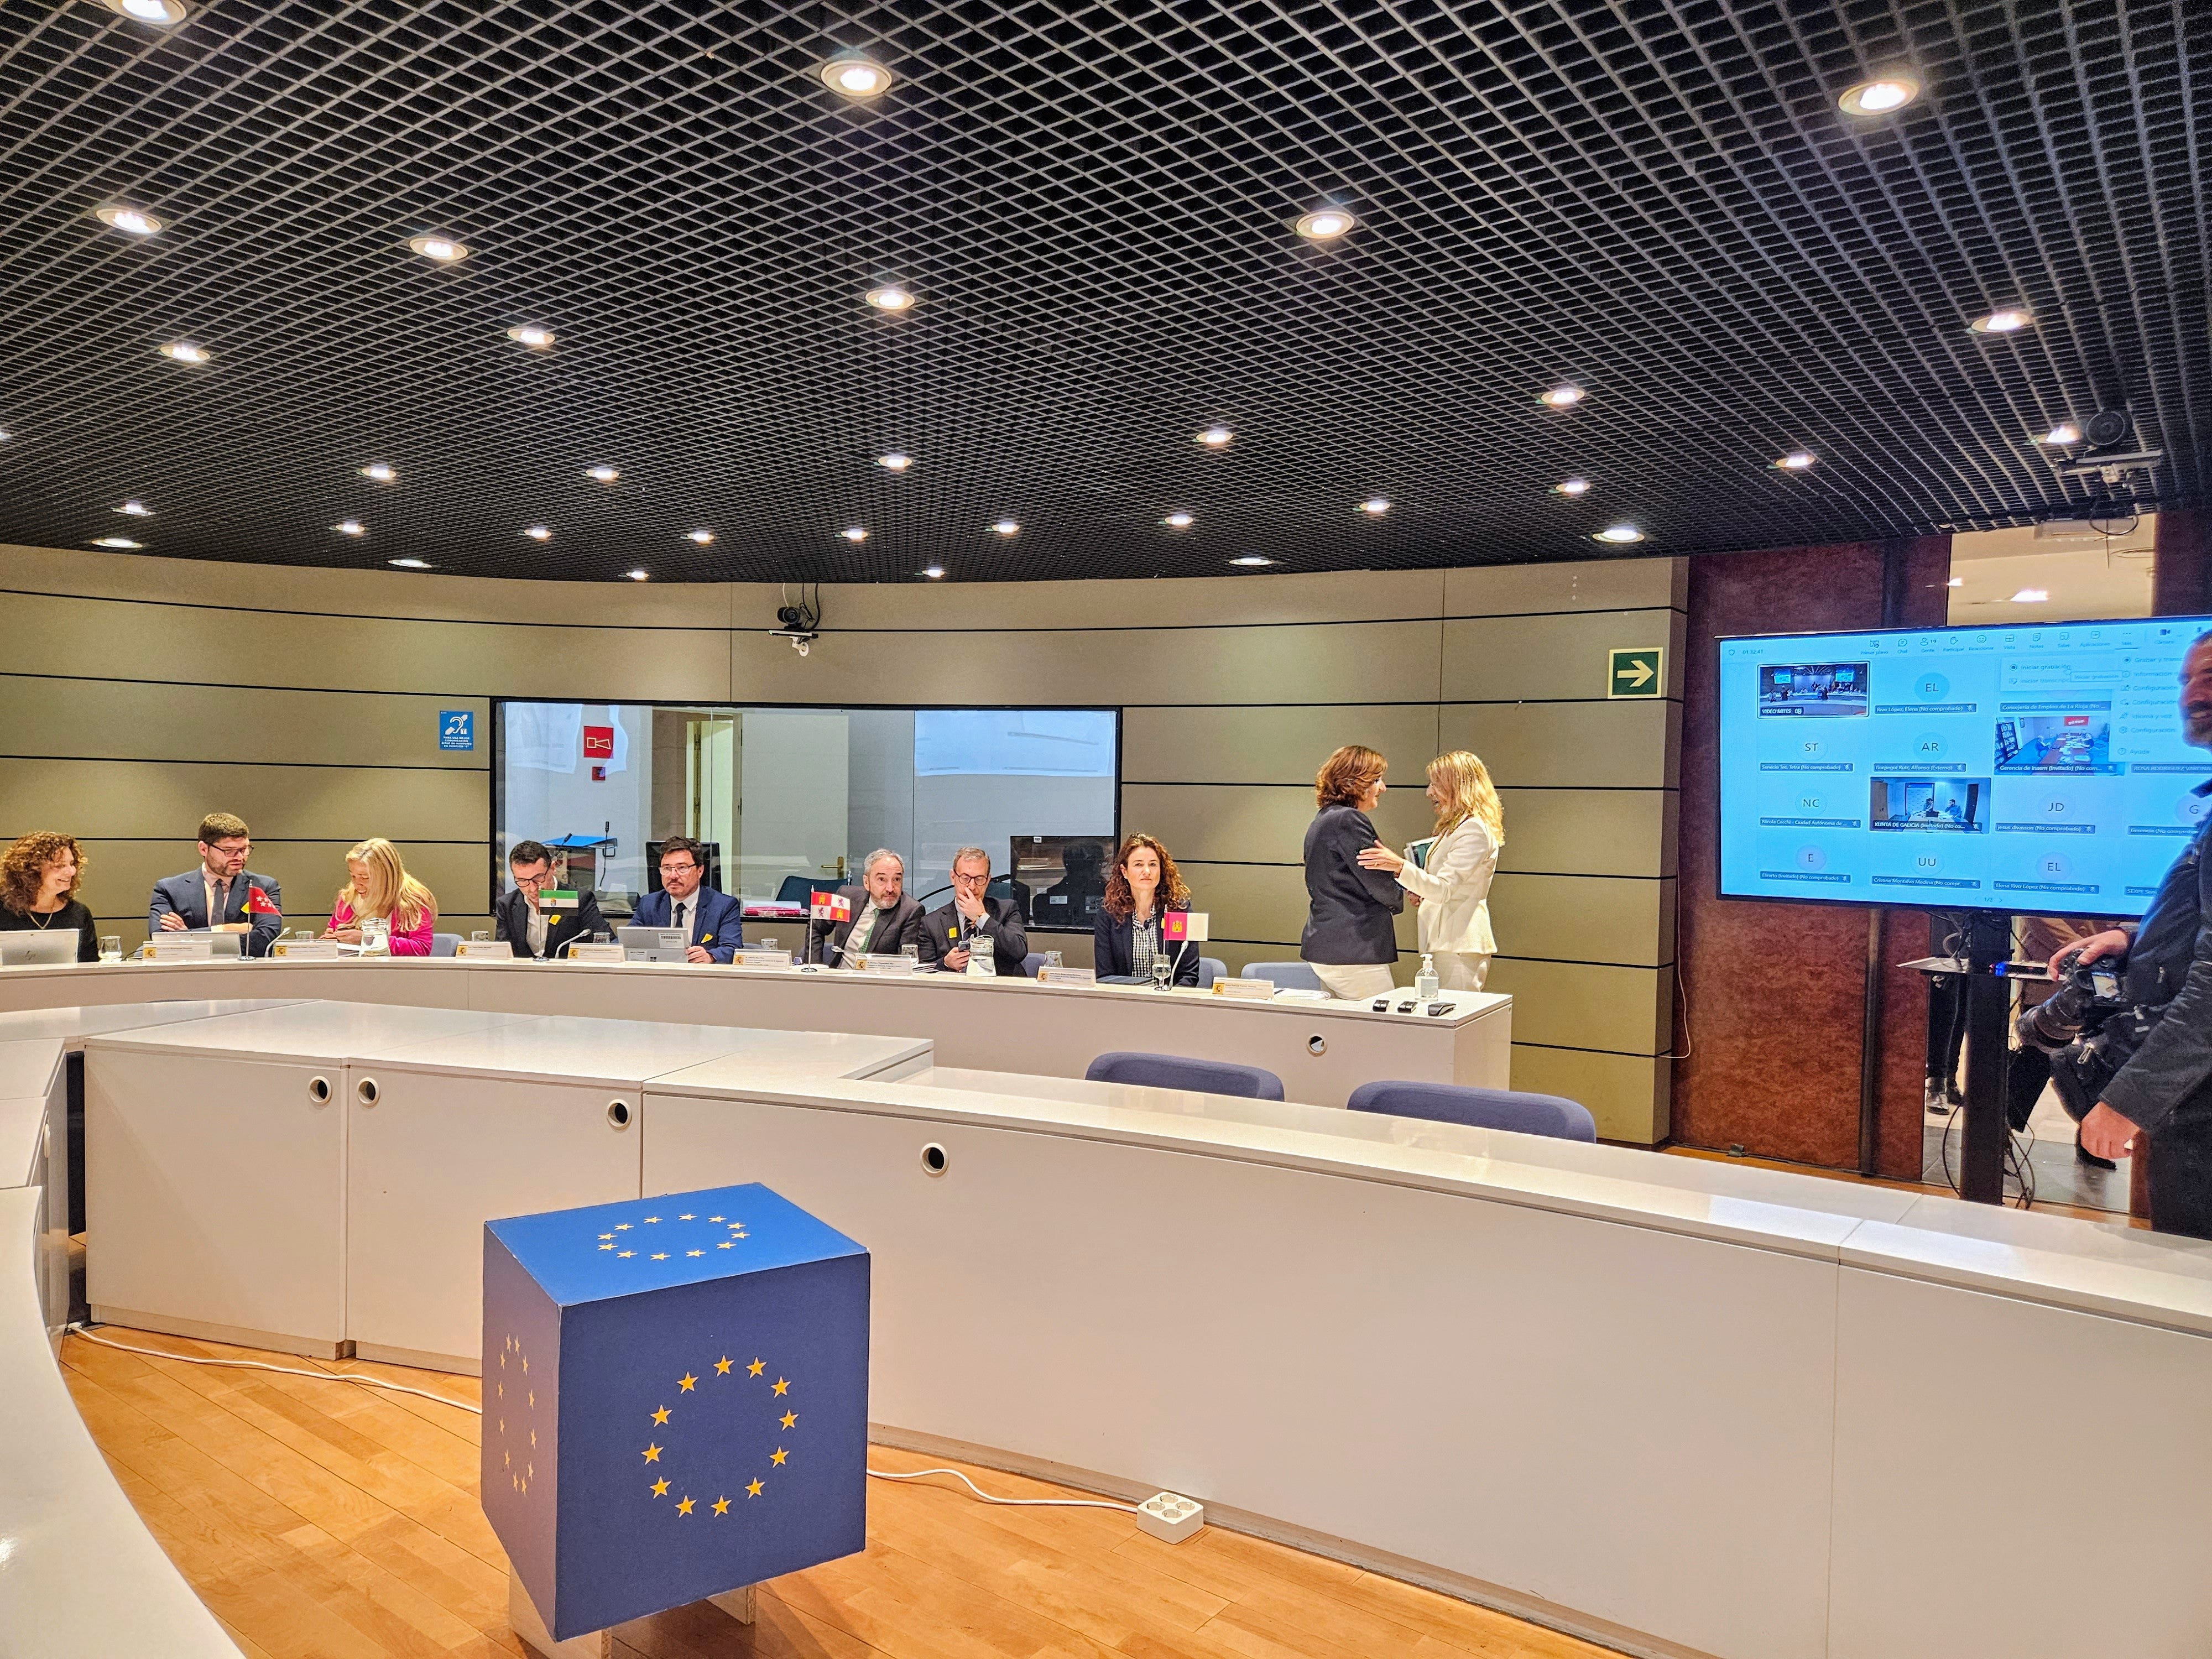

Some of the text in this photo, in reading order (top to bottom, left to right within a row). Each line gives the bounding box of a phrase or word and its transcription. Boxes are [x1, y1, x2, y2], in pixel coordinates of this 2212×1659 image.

[1926, 683, 1939, 692] EL
[1804, 743, 1818, 752] ST
[1921, 743, 1939, 752] AR
[1803, 799, 1819, 807] NC
[2048, 802, 2064, 812] JD
[2189, 805, 2199, 814] G
[1808, 854, 1814, 862] E
[1918, 858, 1936, 867] UU
[2047, 862, 2061, 872] EL
